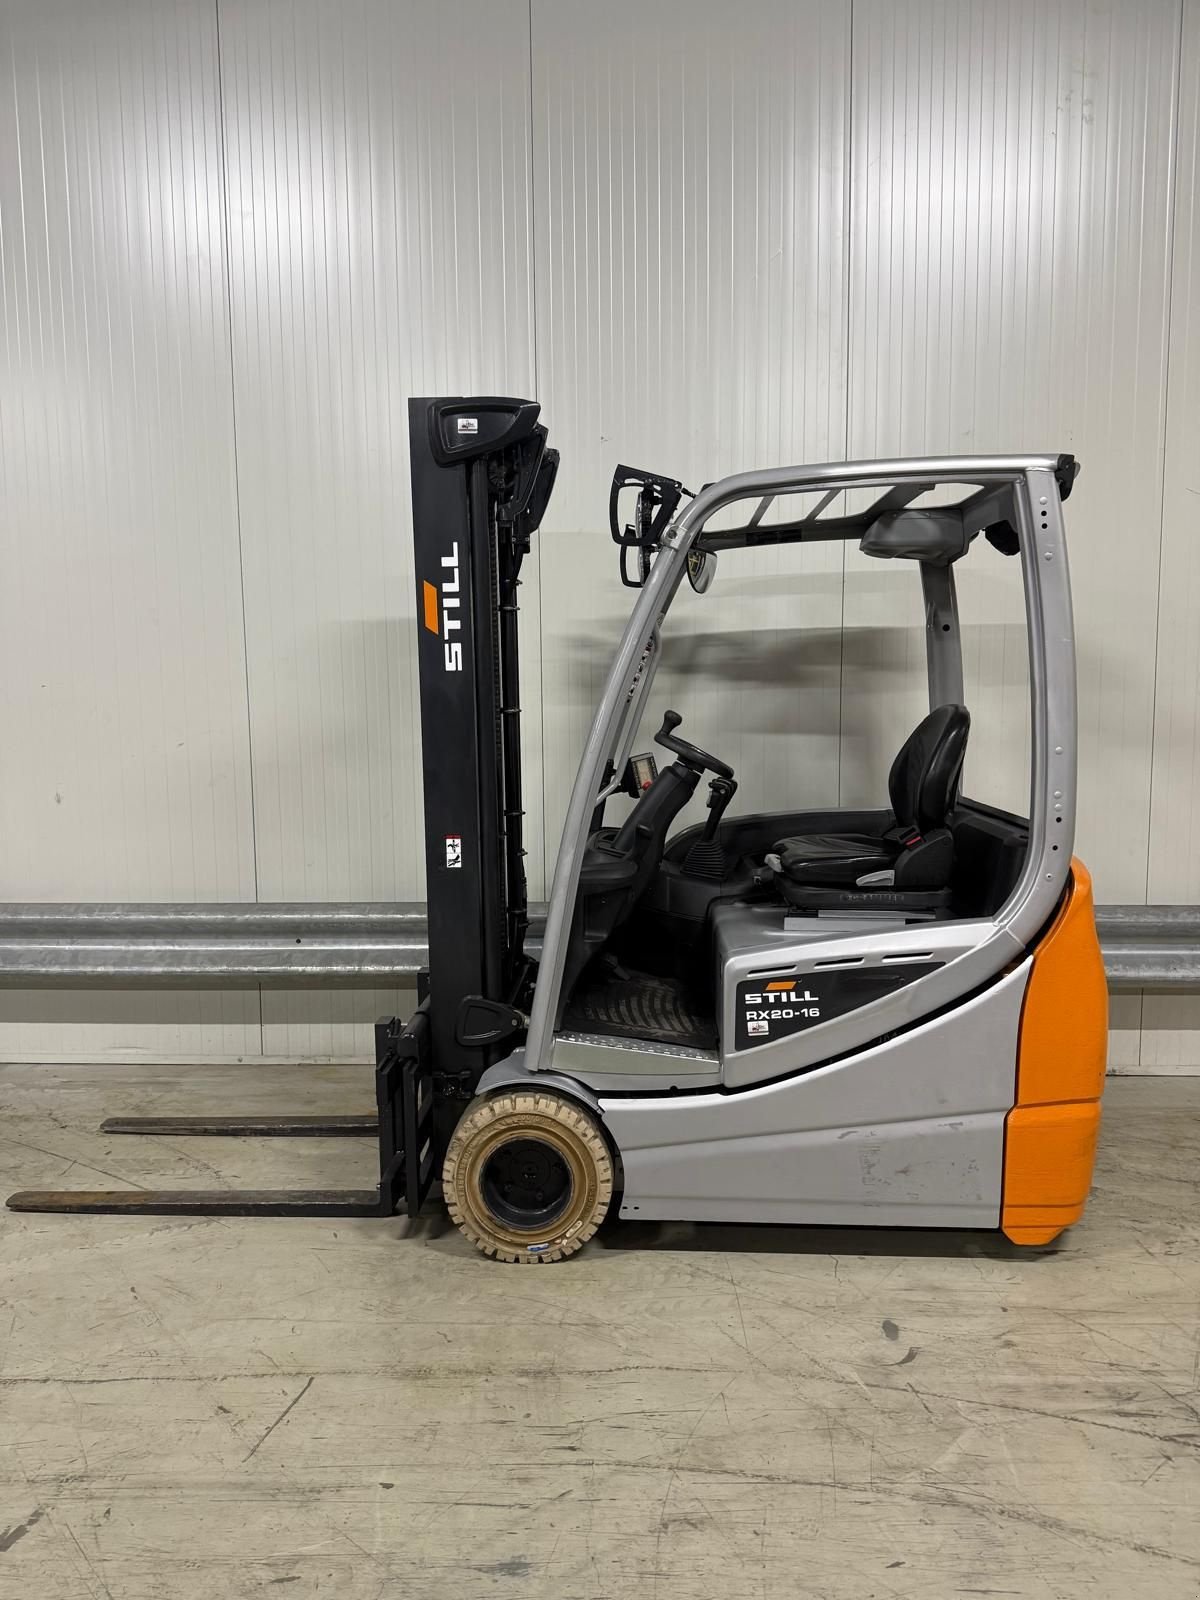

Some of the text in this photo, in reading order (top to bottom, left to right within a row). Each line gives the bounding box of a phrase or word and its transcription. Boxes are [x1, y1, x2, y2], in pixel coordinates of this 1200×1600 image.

[441, 542, 462, 671] STILL
[745, 991, 818, 1004] STILL
[746, 1008, 819, 1020] RX20-16
